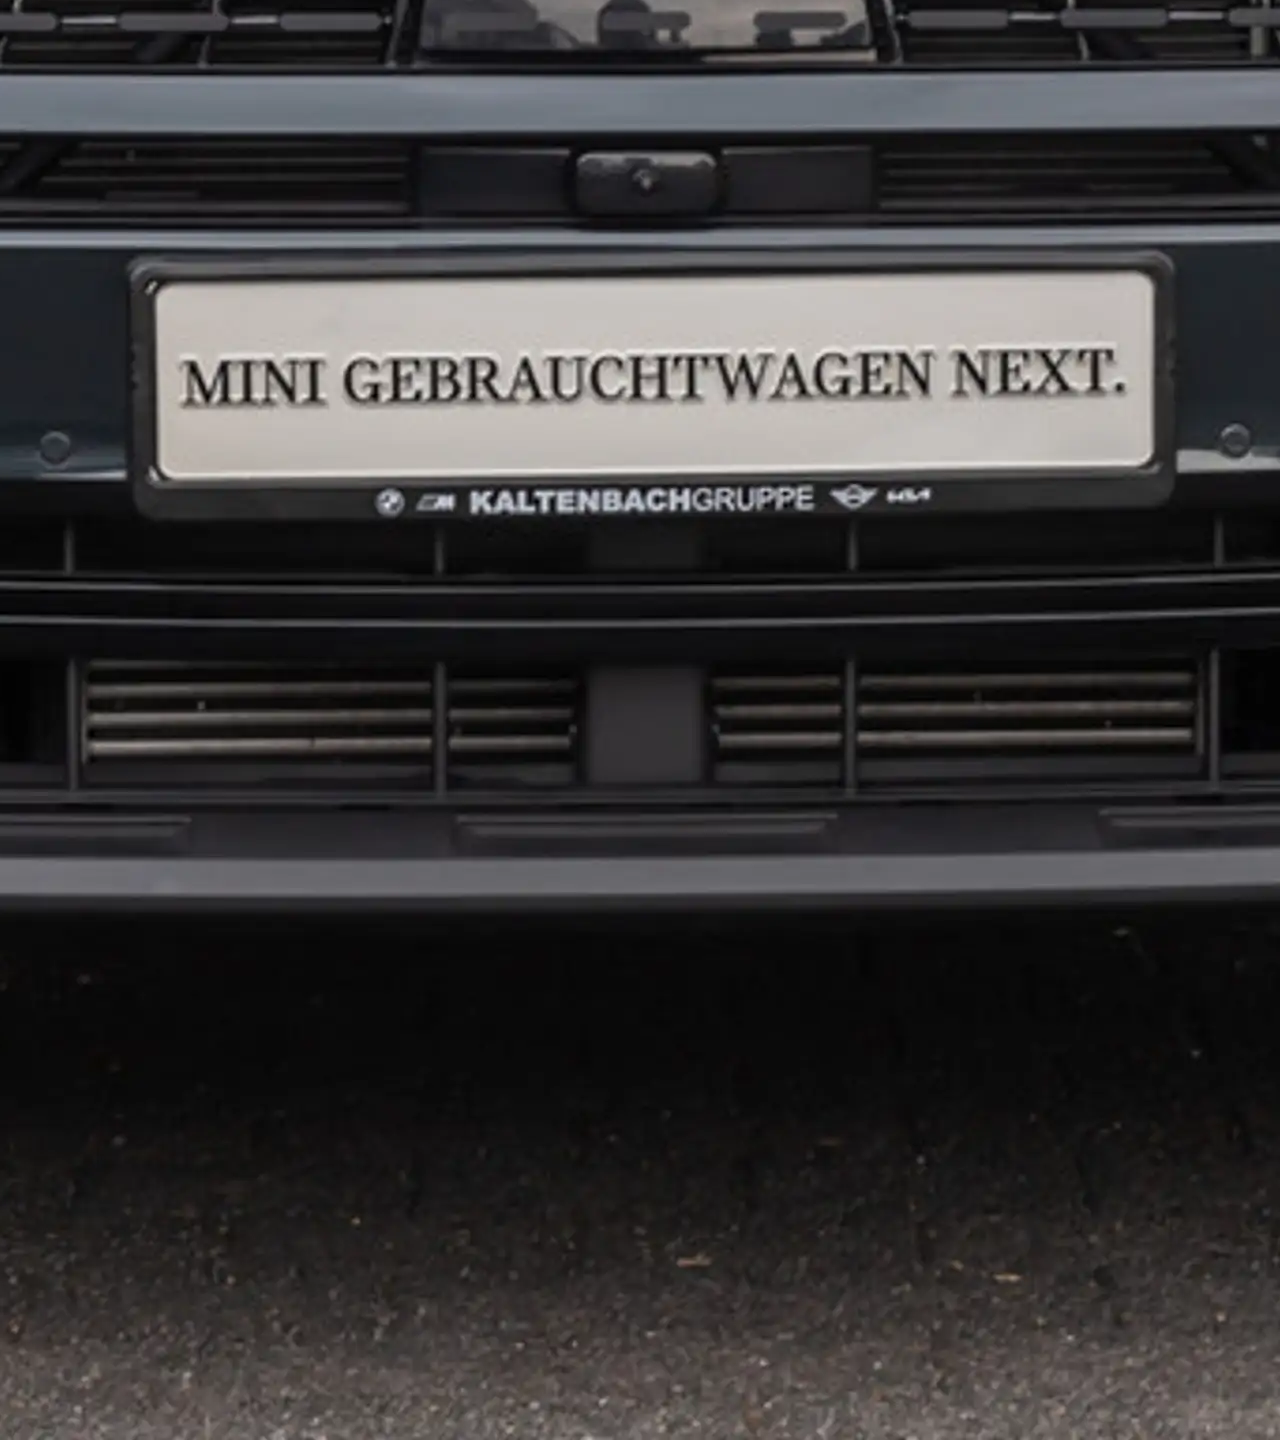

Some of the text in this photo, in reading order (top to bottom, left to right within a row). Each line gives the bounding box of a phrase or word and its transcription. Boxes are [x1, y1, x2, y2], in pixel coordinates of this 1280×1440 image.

[180, 347, 1126, 408] MINI GEBRAUCHTWAGEN NEXT.
[469, 485, 815, 515] KALTENBACHGRUPPE
